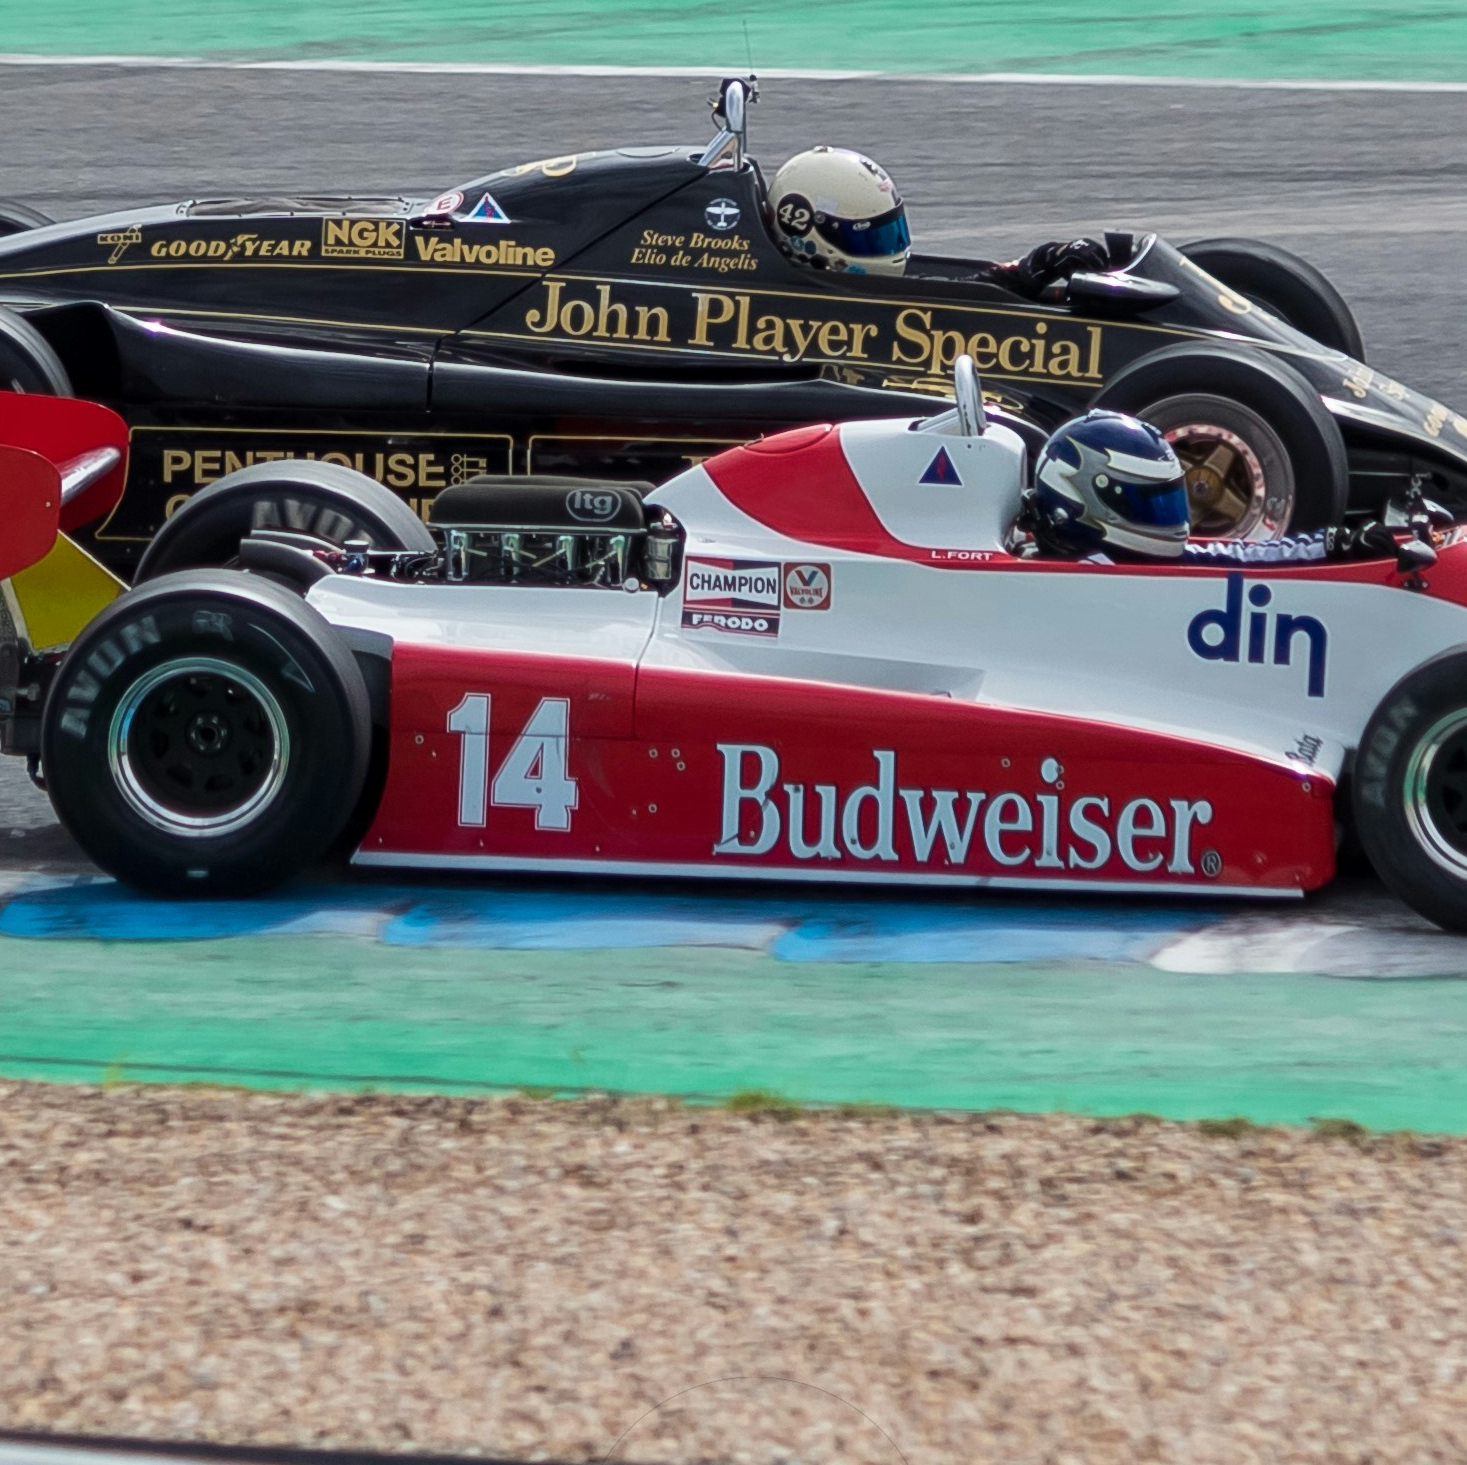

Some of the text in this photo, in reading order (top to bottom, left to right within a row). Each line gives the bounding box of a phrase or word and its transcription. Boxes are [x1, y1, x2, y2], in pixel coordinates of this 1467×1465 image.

[437, 196, 453, 210] E
[779, 203, 811, 230] 42
[326, 219, 400, 247] NGK
[640, 229, 750, 250] Steve Brooks
[324, 247, 402, 257] SPARK PLUGS
[415, 236, 555, 266] Valvoline
[631, 247, 758, 272] Elio de Angelis
[526, 281, 1103, 379] John Player Special
[163, 450, 446, 487] PENUSE
[689, 573, 777, 594] CHAMPION
[789, 585, 823, 598] VALVOLINE
[692, 613, 769, 632] FERODO
[1187, 571, 1328, 698] din
[446, 692, 579, 832] 14
[714, 743, 1214, 875] Budweiser
